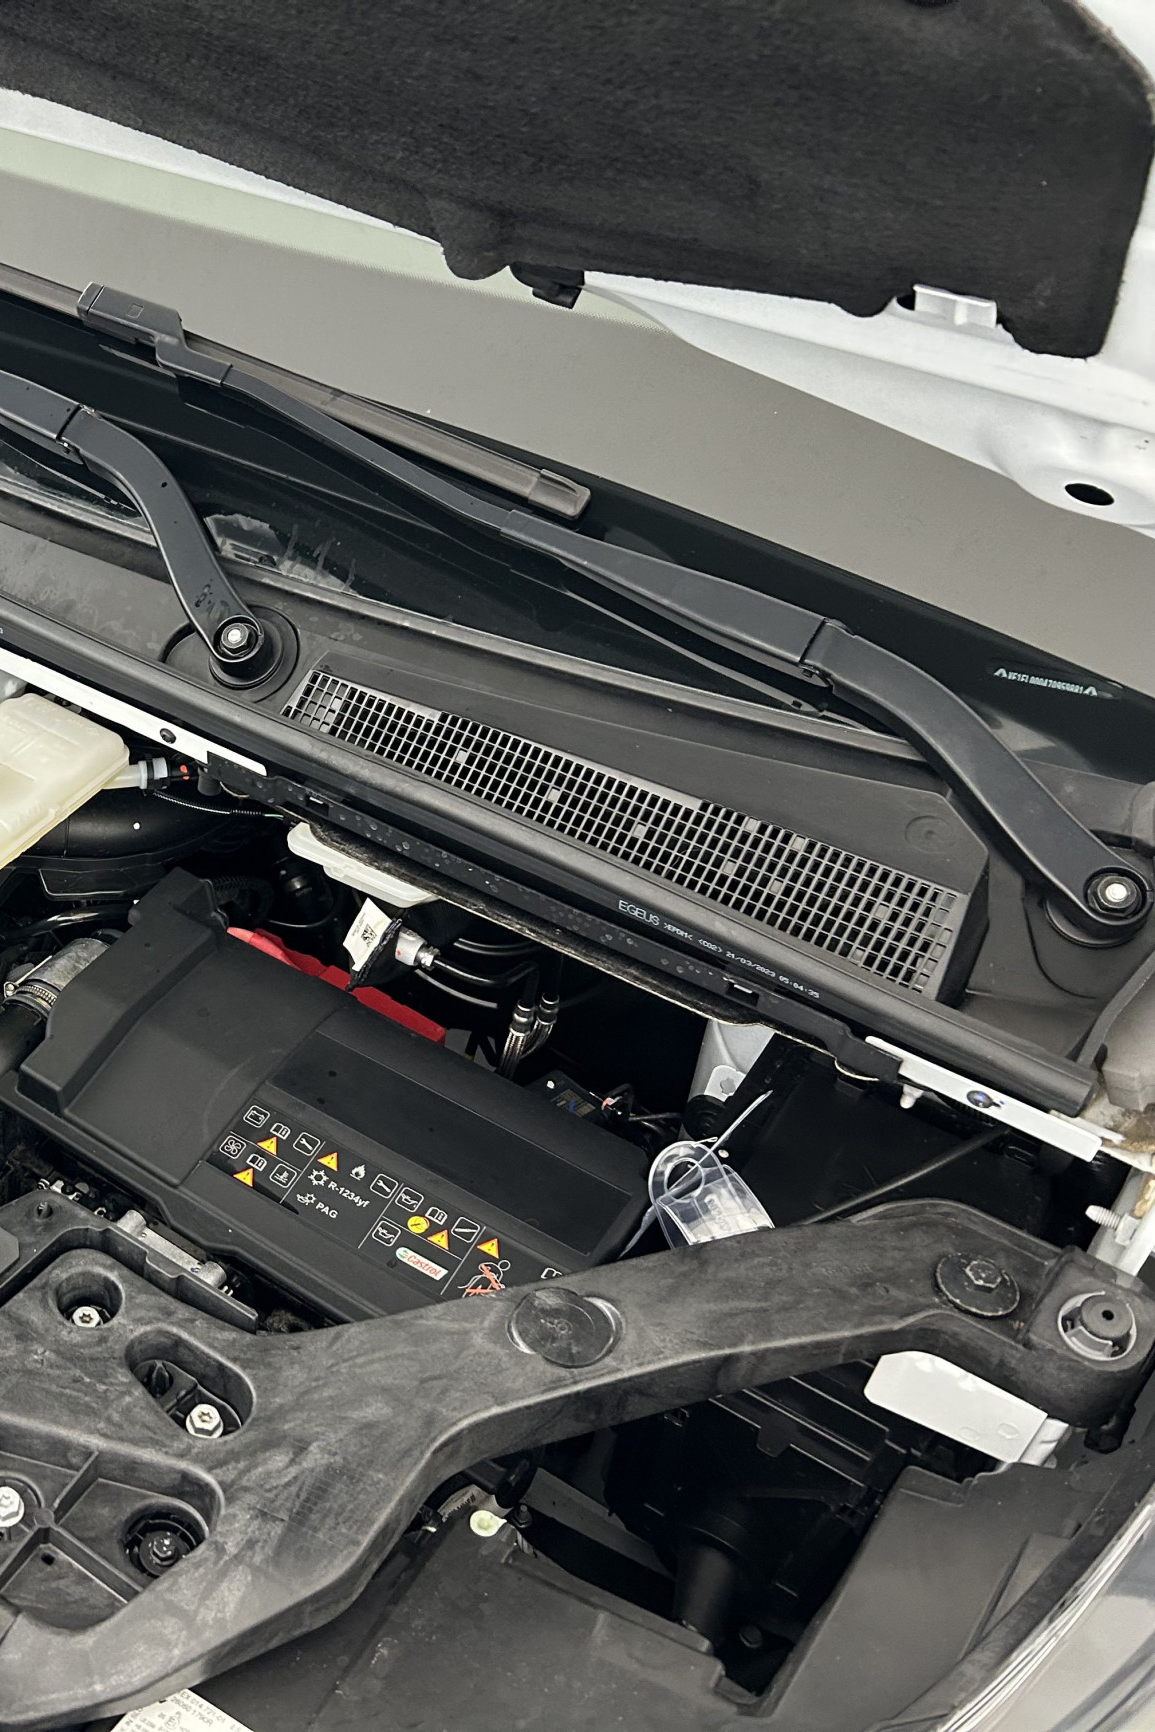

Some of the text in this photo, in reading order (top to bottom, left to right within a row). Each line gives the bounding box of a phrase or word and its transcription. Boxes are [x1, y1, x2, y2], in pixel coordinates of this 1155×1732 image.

[618, 899, 661, 926] EGEUS
[725, 950, 777, 978] 21/03/2023
[327, 1181, 371, 1208] R-1234yf
[315, 1201, 339, 1219] PAG
[407, 1254, 442, 1278] Castrol
